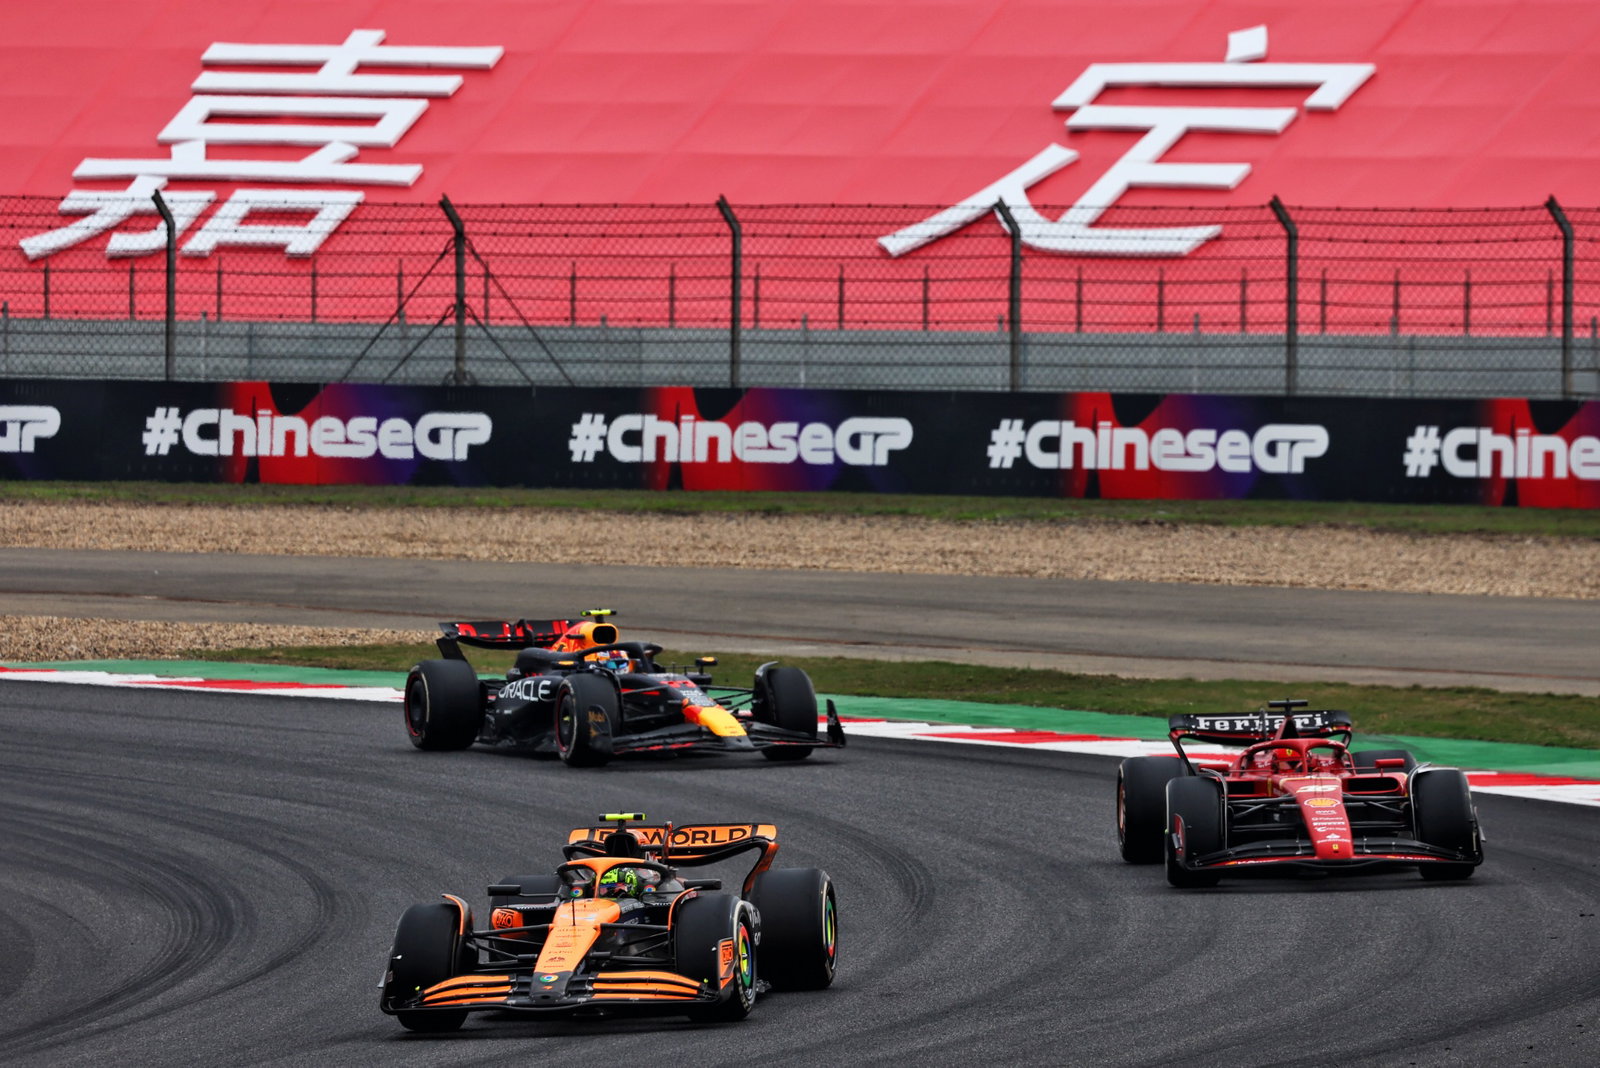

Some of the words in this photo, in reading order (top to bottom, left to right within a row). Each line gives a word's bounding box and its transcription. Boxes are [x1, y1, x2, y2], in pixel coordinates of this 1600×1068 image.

[142, 406, 493, 462] #ChineseGP
[569, 411, 913, 467] #ChineseGP
[987, 418, 1330, 475] #ChineseGP
[498, 680, 558, 702] ORACLE
